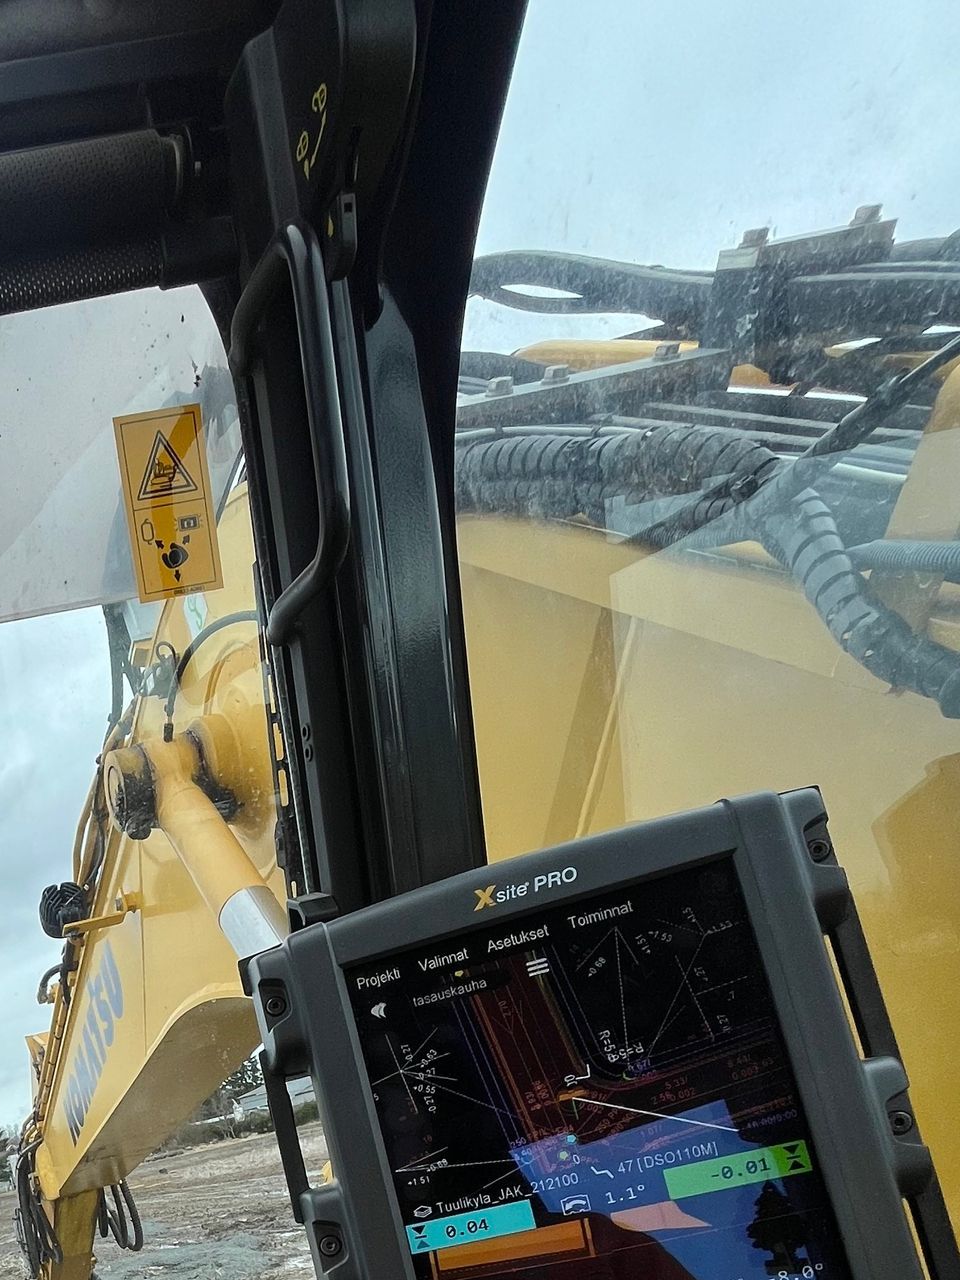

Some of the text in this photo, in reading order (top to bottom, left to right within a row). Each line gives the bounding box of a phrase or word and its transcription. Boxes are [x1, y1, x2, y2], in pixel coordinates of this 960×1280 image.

[534, 867, 578, 893] PRO
[356, 900, 634, 989] Projekti Valinnat Asetukset Toiminnat
[413, 979, 488, 1008] tasauskauha
[63, 937, 124, 1148] KOMATSU
[711, 1157, 771, 1180] -0.01
[445, 1218, 489, 1238] 0.04
